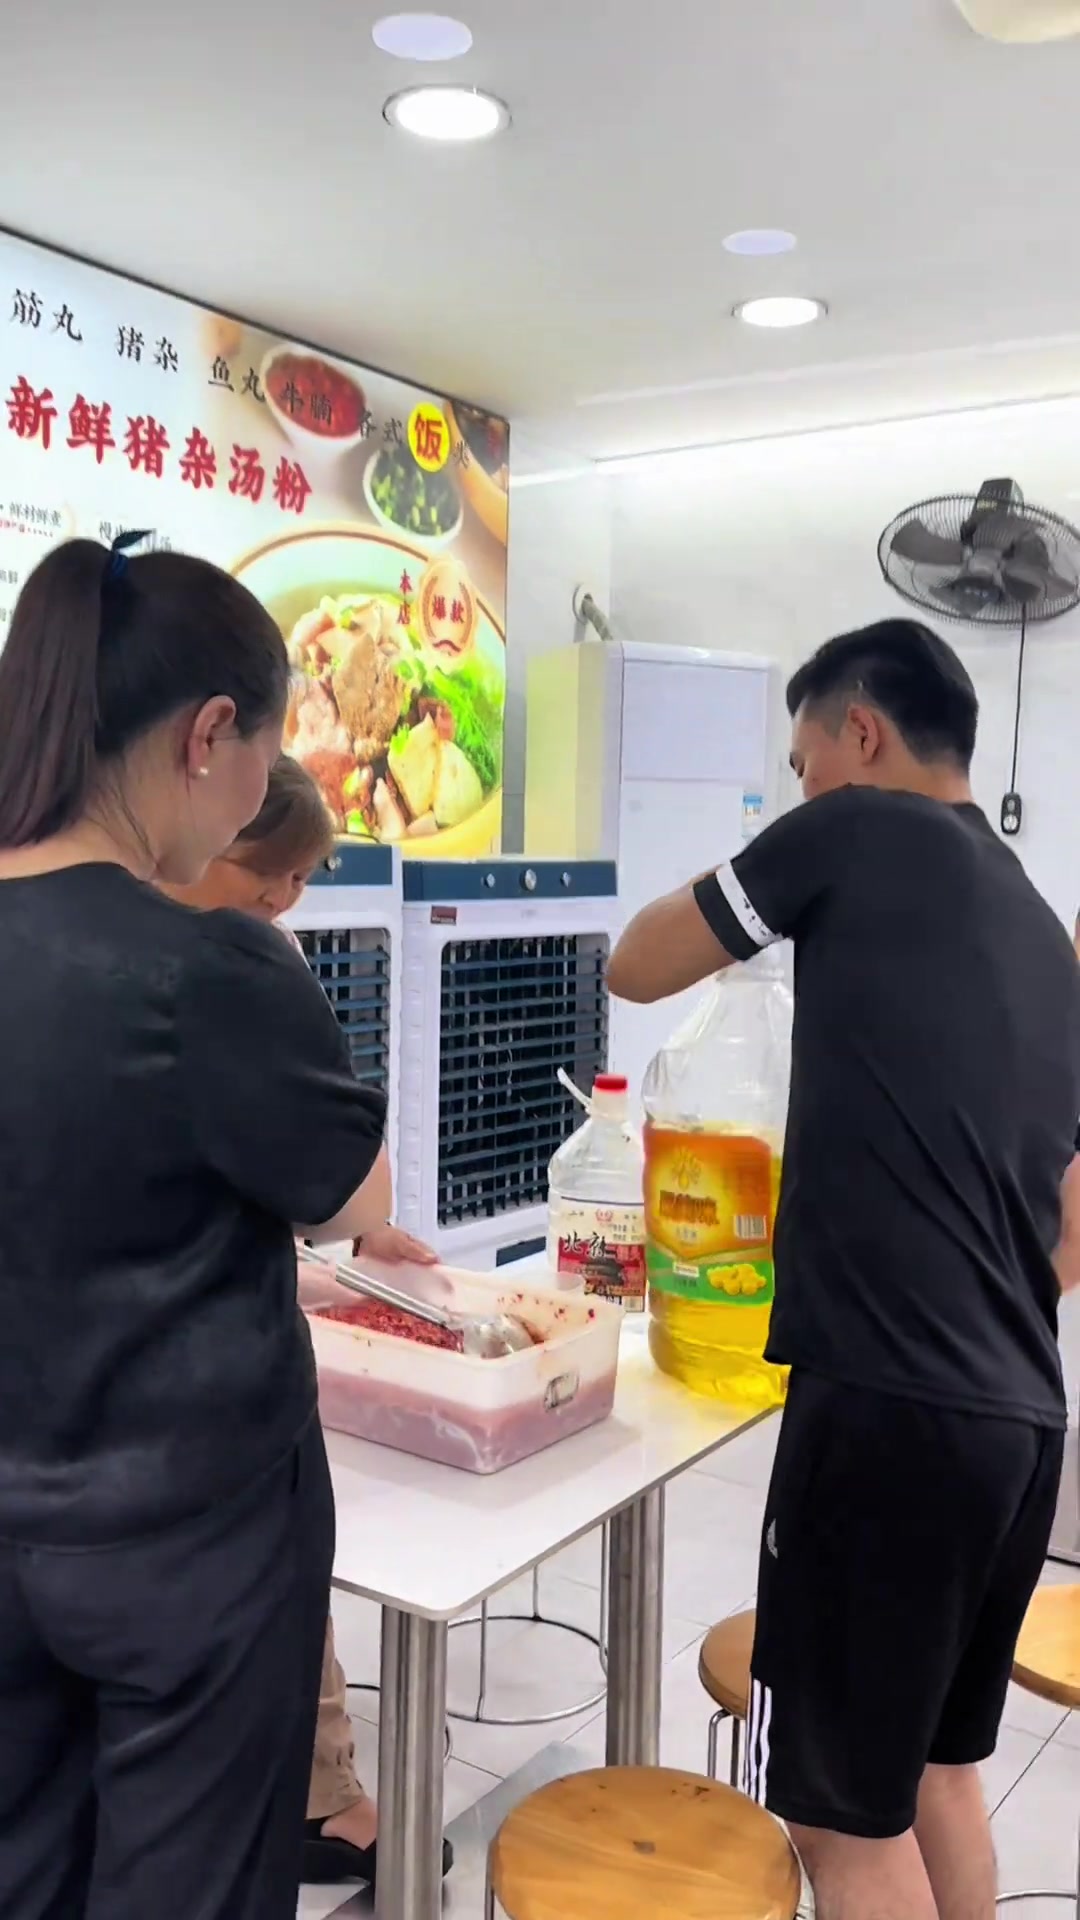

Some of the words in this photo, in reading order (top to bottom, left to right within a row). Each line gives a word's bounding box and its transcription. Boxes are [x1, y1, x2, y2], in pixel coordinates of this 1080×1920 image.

[10, 288, 82, 342] 筋丸
[117, 326, 178, 372] 猪杂
[208, 356, 265, 402] 鱼丸
[280, 381, 332, 425] 牛腩
[6, 375, 312, 515] 新鲜猪杂汤粉
[397, 568, 413, 625] 本店
[431, 594, 465, 624] 爆款
